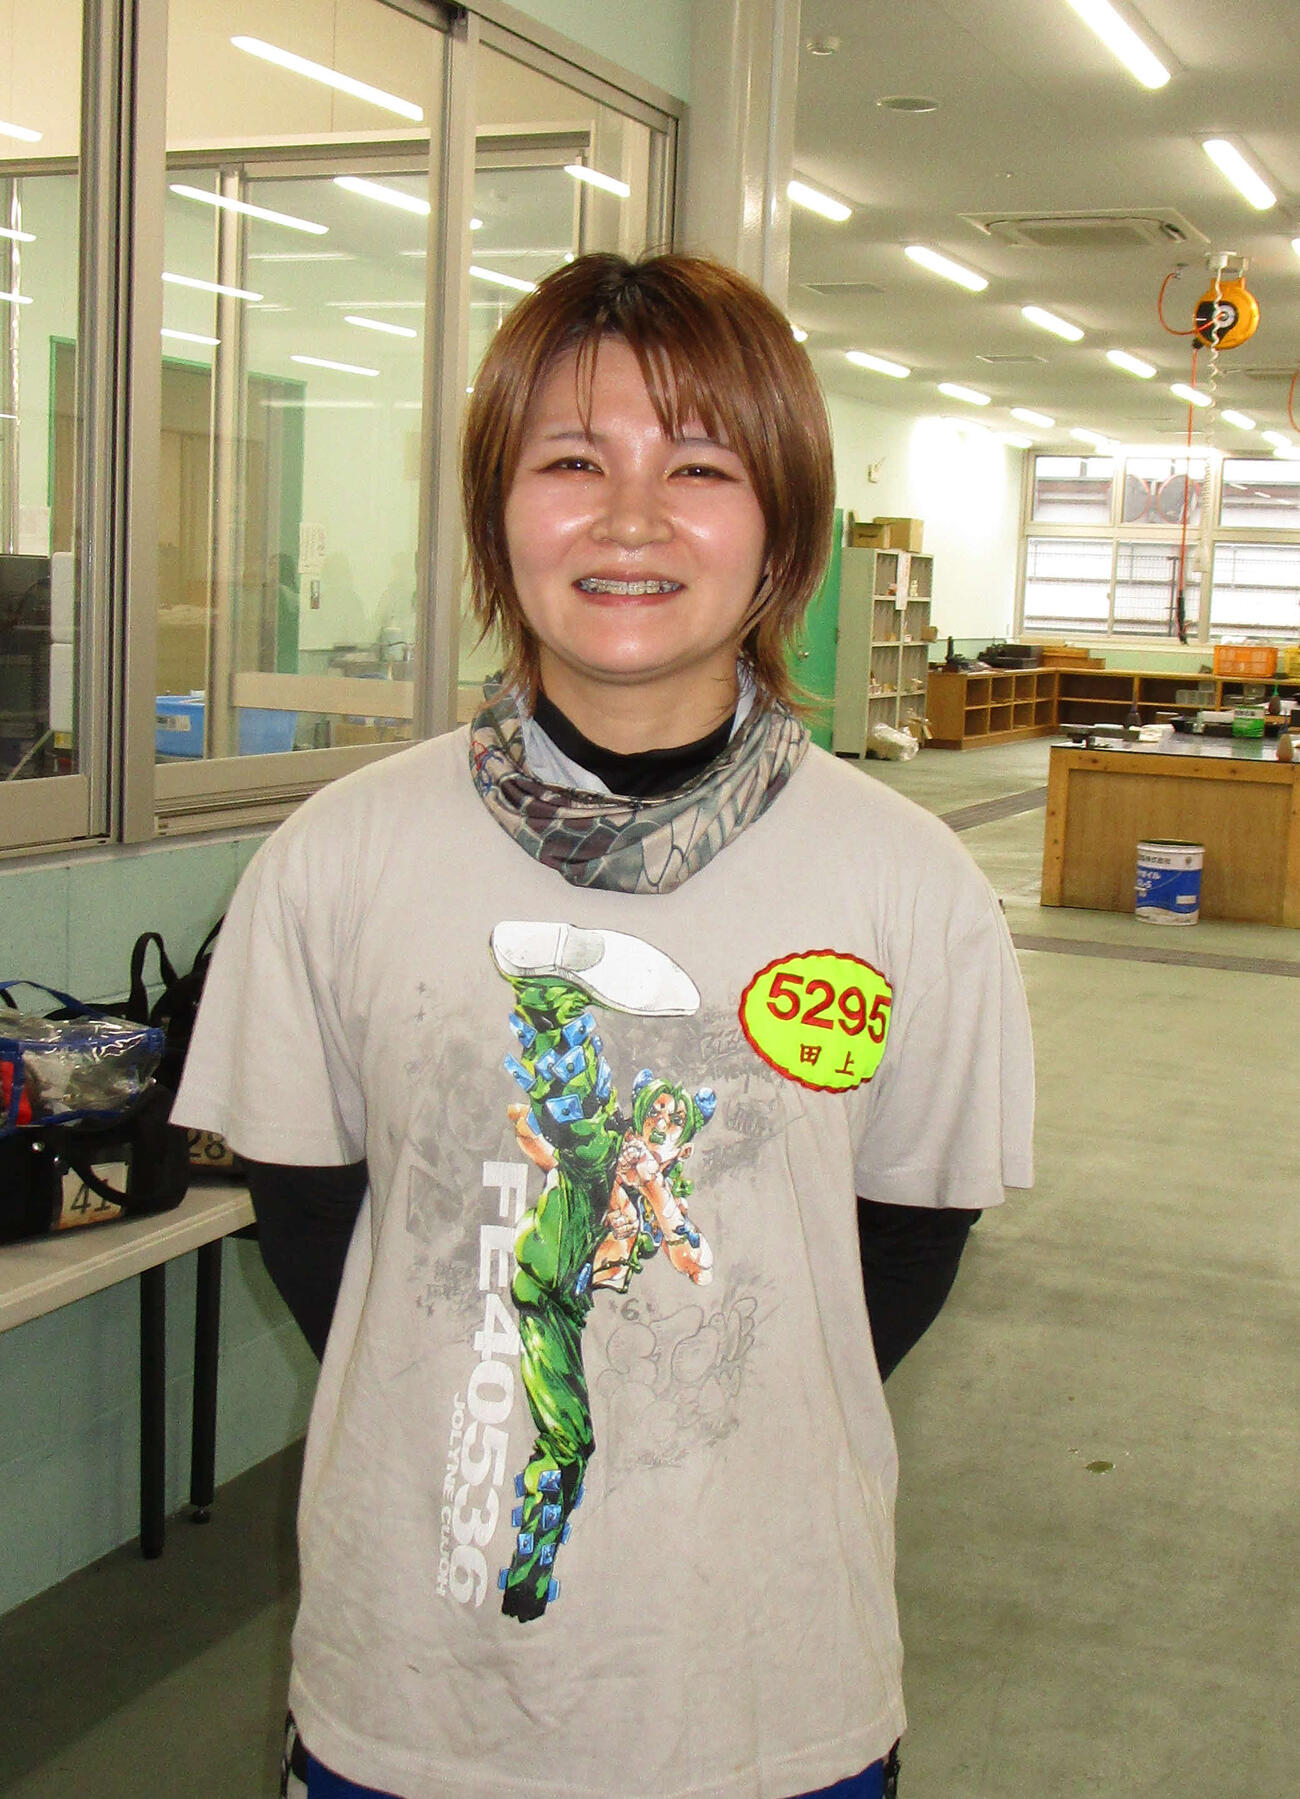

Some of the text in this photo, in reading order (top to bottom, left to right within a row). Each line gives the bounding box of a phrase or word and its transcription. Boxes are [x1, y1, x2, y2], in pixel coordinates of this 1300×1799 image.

[766, 972, 892, 1044] 5295
[800, 1043, 854, 1076] 田上
[448, 1161, 528, 1607] FE40536
[442, 1392, 466, 1502] JOLYNE
